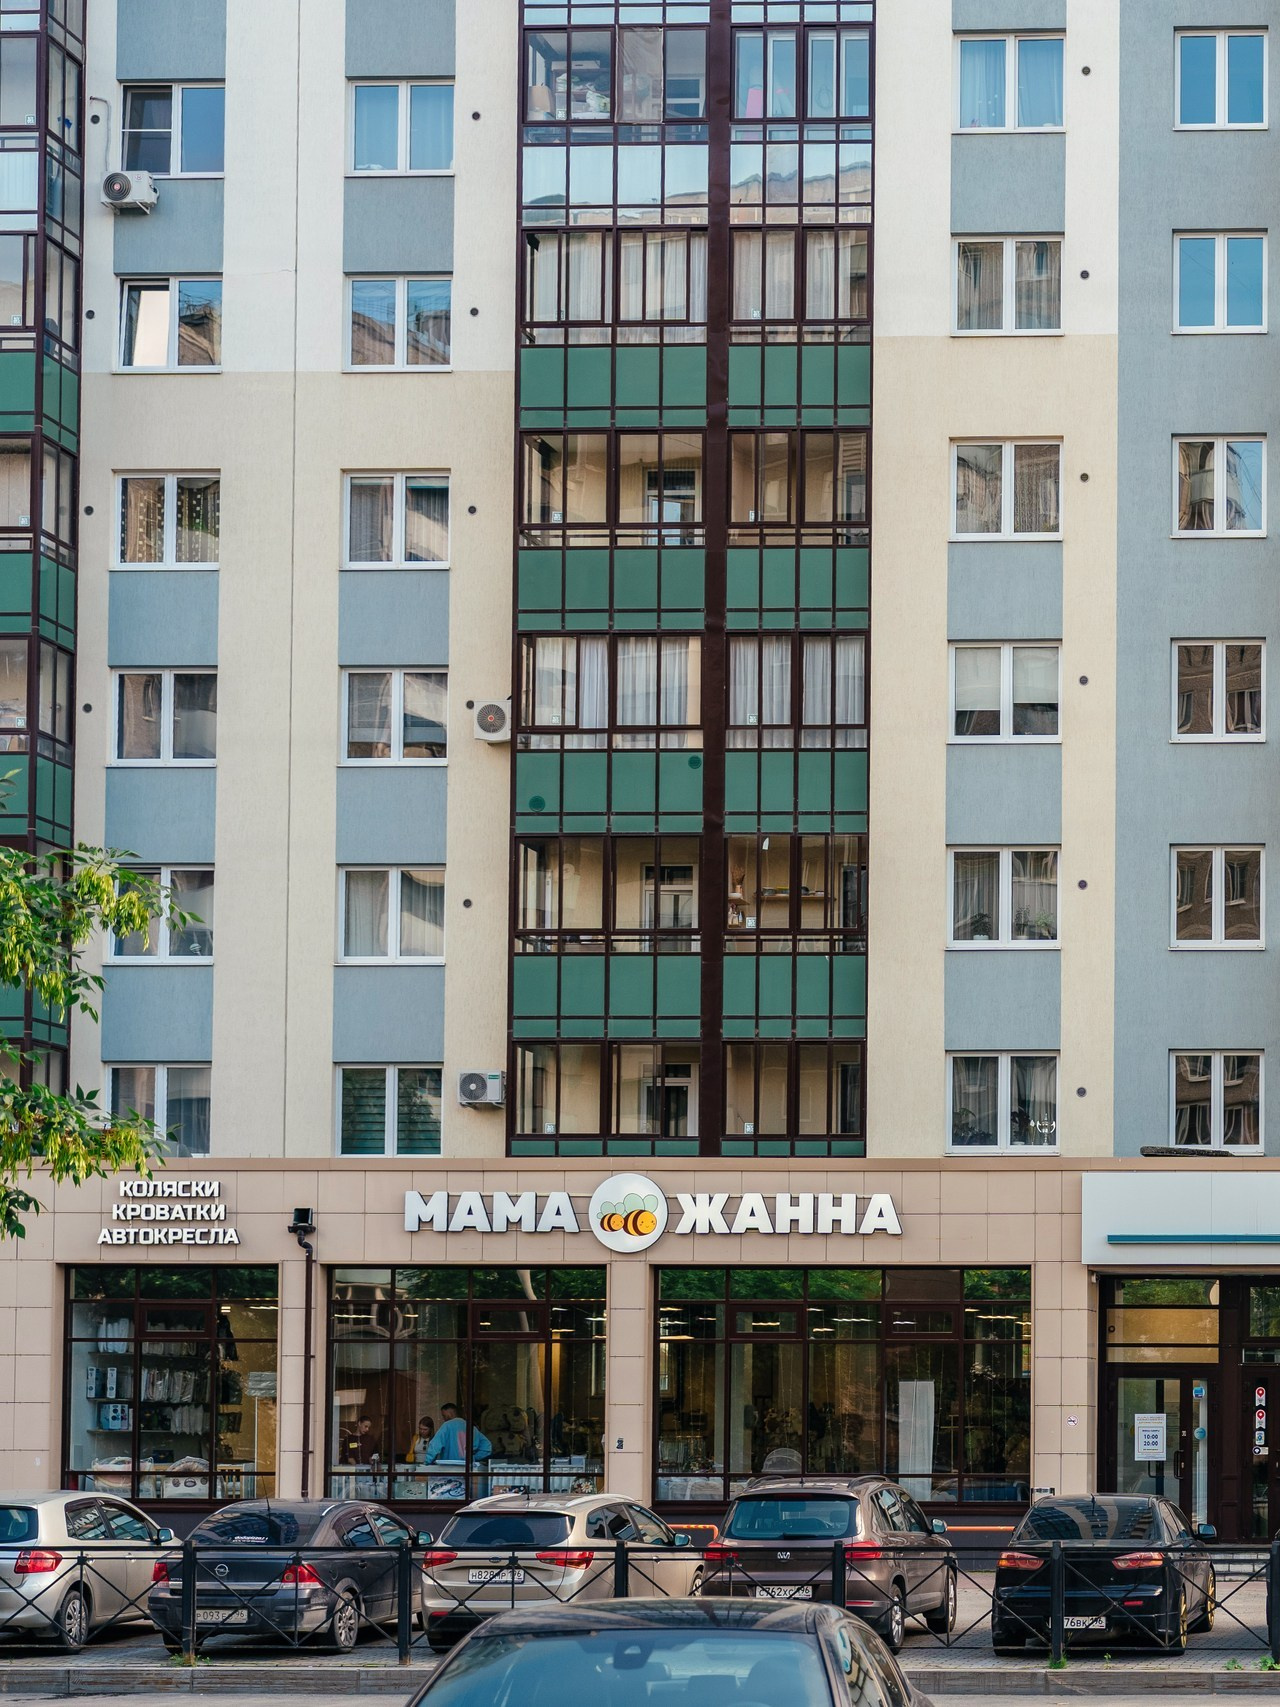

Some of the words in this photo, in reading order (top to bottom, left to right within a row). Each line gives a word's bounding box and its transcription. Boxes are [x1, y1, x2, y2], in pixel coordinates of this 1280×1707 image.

[119, 1180, 221, 1197] КОЛЯСКИ
[112, 1203, 227, 1221] КРОВАТКИ
[405, 1190, 580, 1233] МАМА
[674, 1192, 903, 1235] ЖАННА
[97, 1228, 240, 1245] АВТОКРЕСЛА
